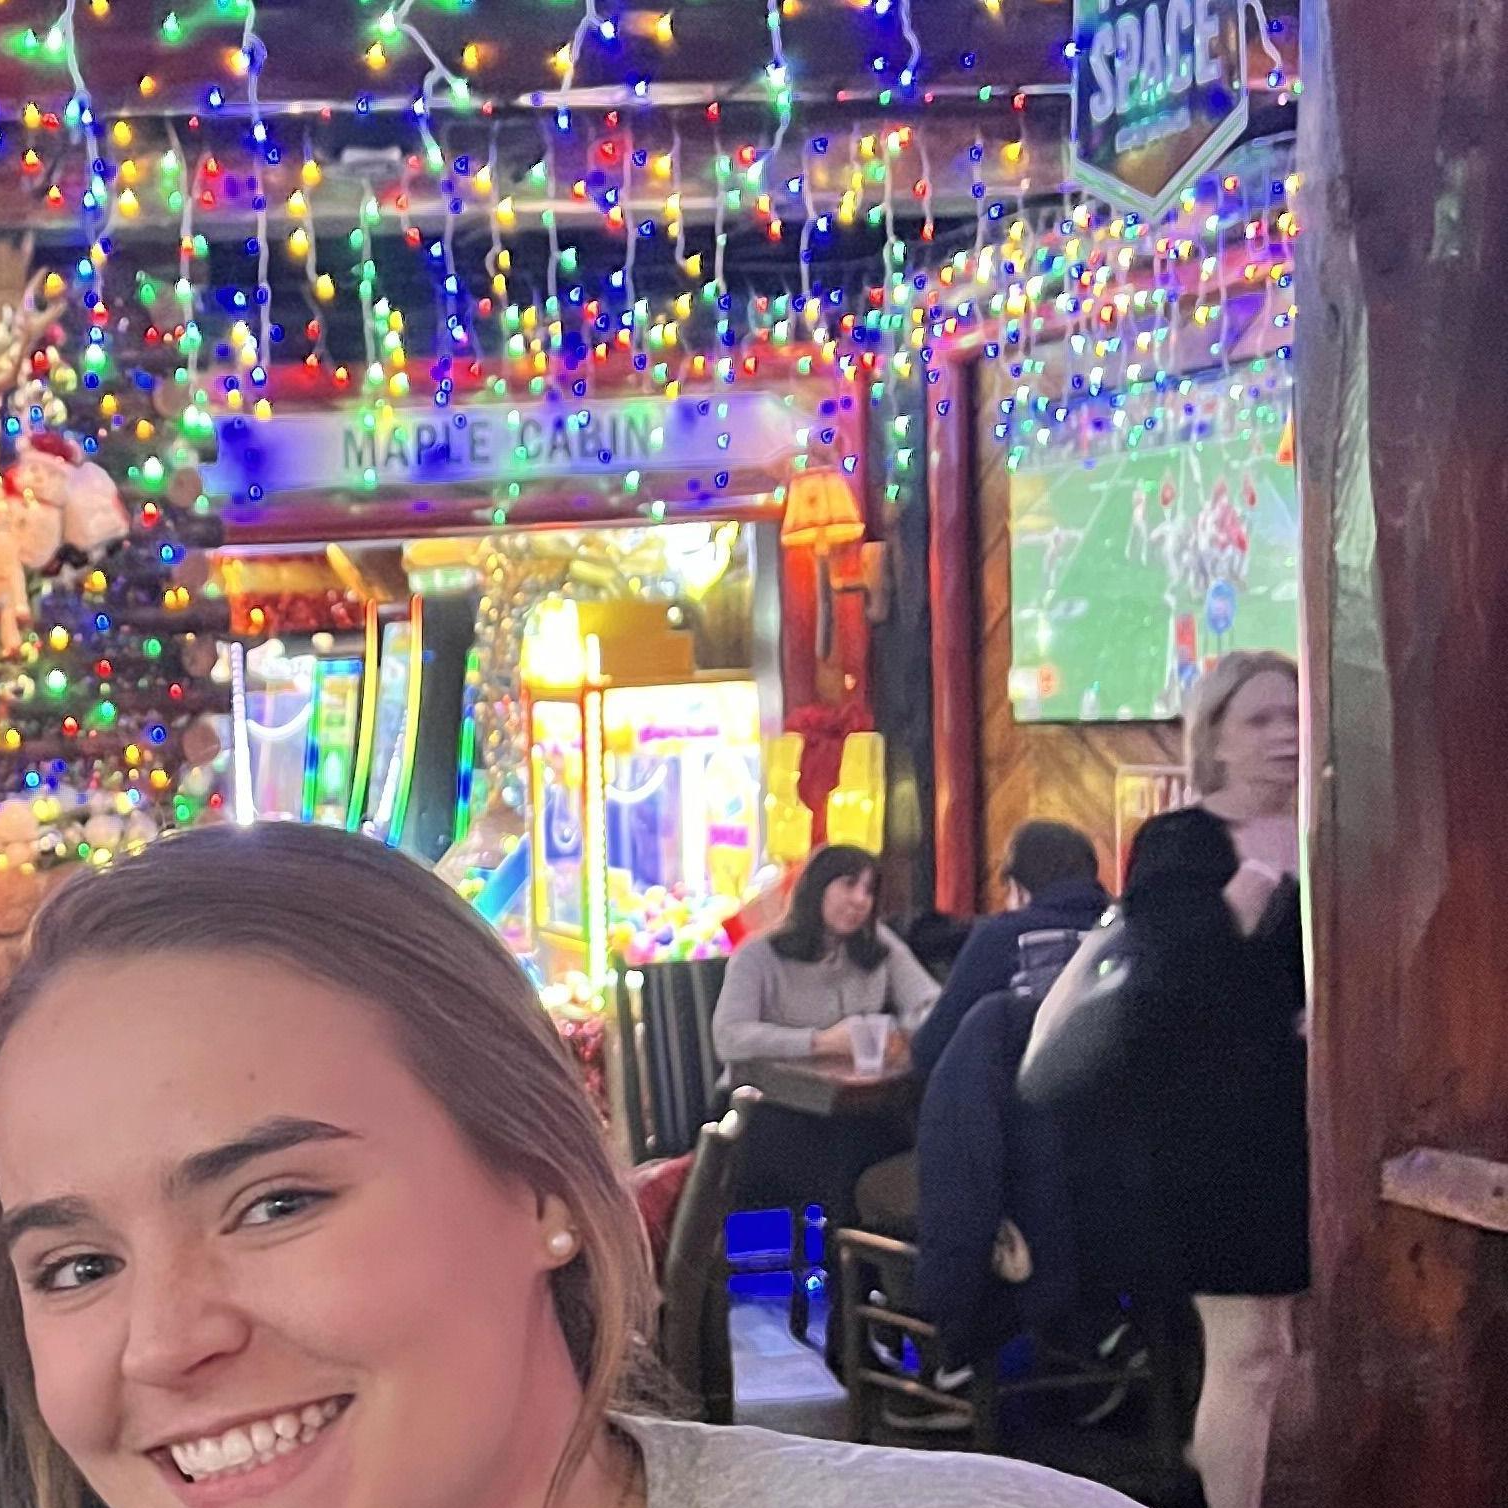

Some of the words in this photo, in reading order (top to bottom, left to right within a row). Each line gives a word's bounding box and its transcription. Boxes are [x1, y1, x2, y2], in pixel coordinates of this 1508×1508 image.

[1089, 0, 1223, 122] SPACE
[344, 420, 492, 469] MAPLE
[520, 413, 652, 462] CABIN
